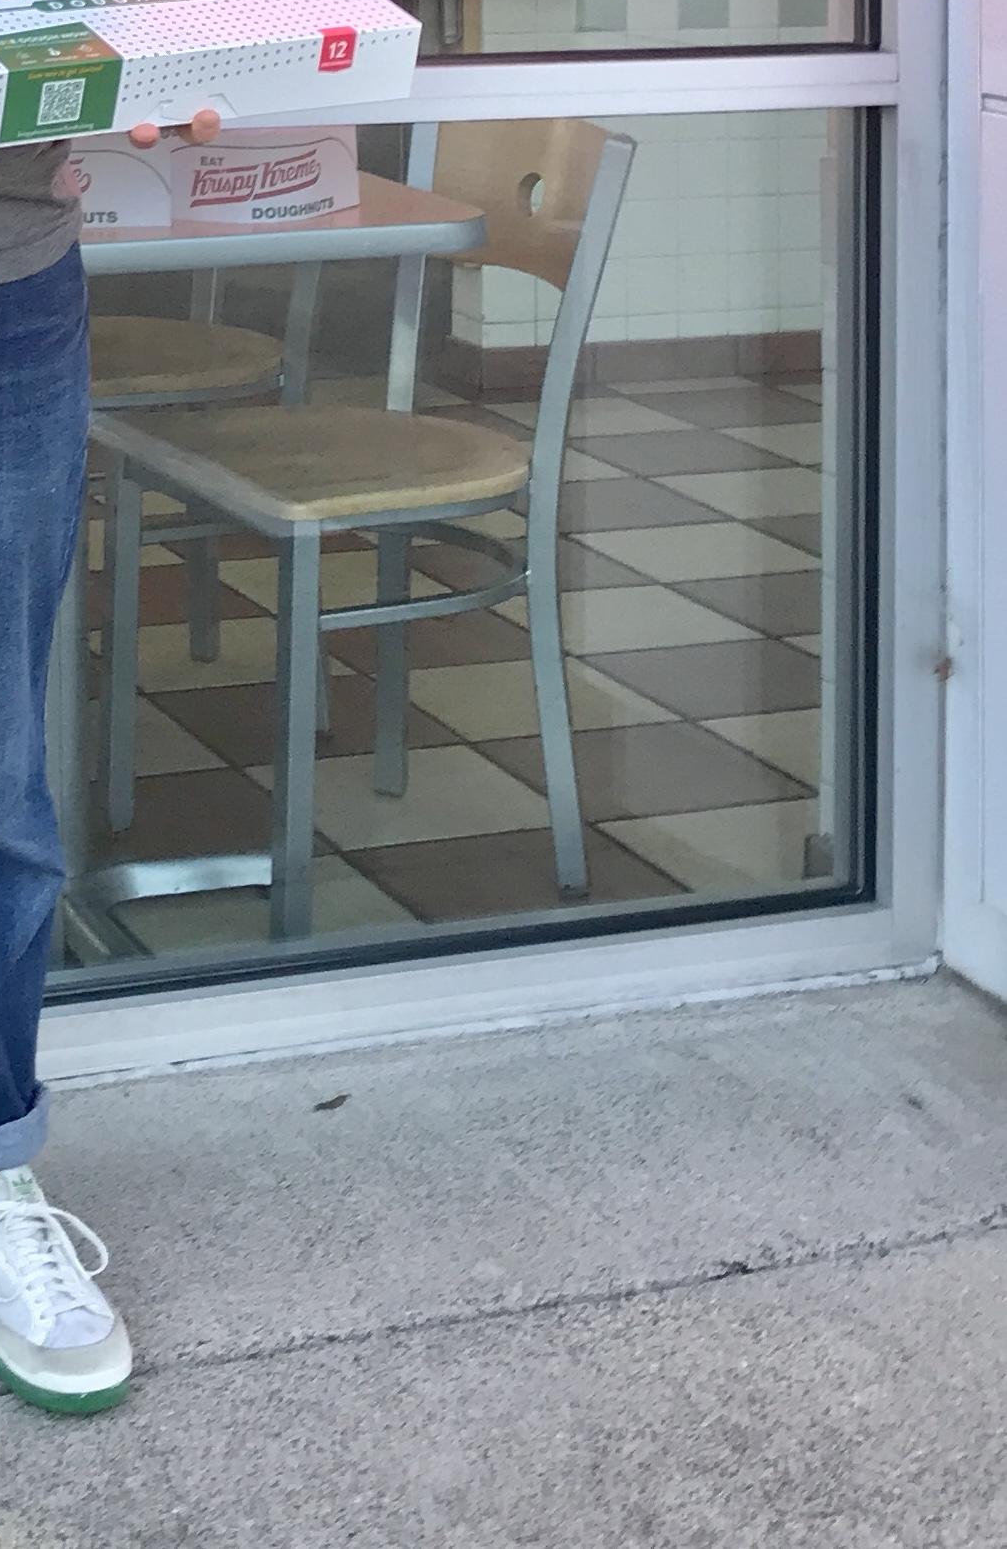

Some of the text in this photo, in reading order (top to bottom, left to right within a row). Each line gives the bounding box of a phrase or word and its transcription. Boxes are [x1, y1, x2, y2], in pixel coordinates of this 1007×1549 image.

[329, 41, 349, 60] 12
[200, 156, 225, 167] EAT
[190, 149, 322, 208] Krispy Kreme
[251, 197, 335, 220] DOUGHNUTS
